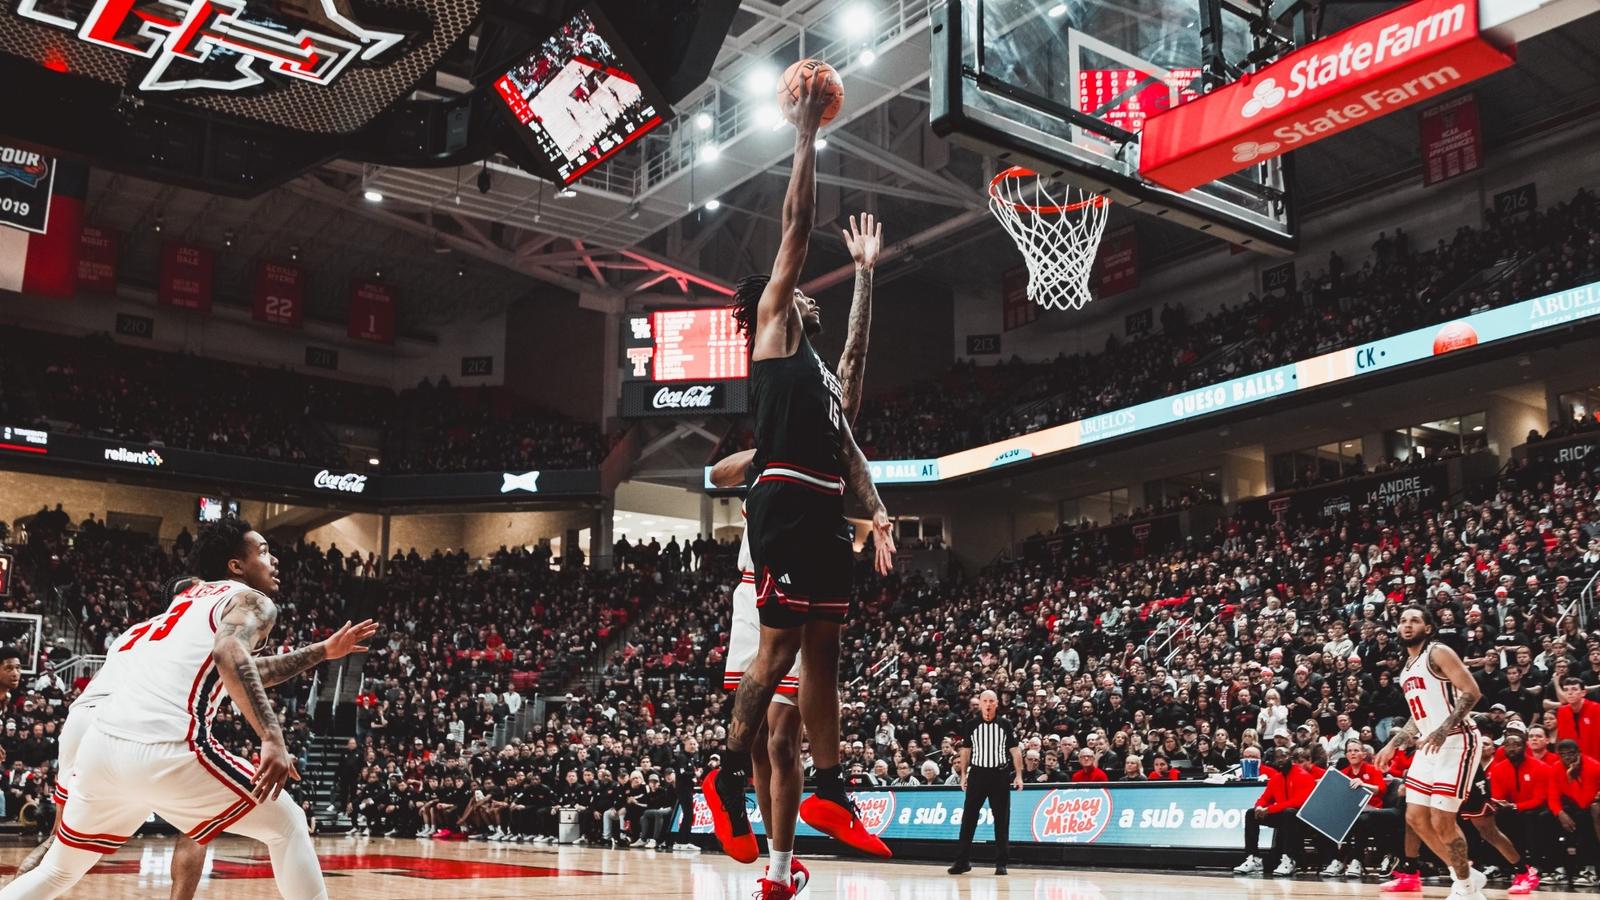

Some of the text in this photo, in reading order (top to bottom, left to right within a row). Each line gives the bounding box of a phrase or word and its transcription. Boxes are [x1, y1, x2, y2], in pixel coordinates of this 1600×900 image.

[0, 146, 40, 167] OUR
[0, 198, 30, 216] 019
[1502, 190, 1529, 212] 216
[265, 296, 293, 318] 22
[1528, 286, 1600, 320] ABUEL
[368, 314, 376, 333] 1
[1172, 348, 1376, 415] QUESO BALLS CK
[829, 395, 839, 431] 15
[104, 447, 148, 465] reliant
[886, 465, 917, 478] BALL
[922, 465, 933, 476] AT
[1378, 476, 1421, 496] ANDRE
[1367, 491, 1377, 504] 14
[1409, 695, 1427, 721] 21
[899, 807, 909, 824] a
[913, 802, 947, 825] sub
[1045, 796, 1101, 816] Jersey
[1119, 808, 1134, 828] a
[1140, 801, 1184, 829] sub
